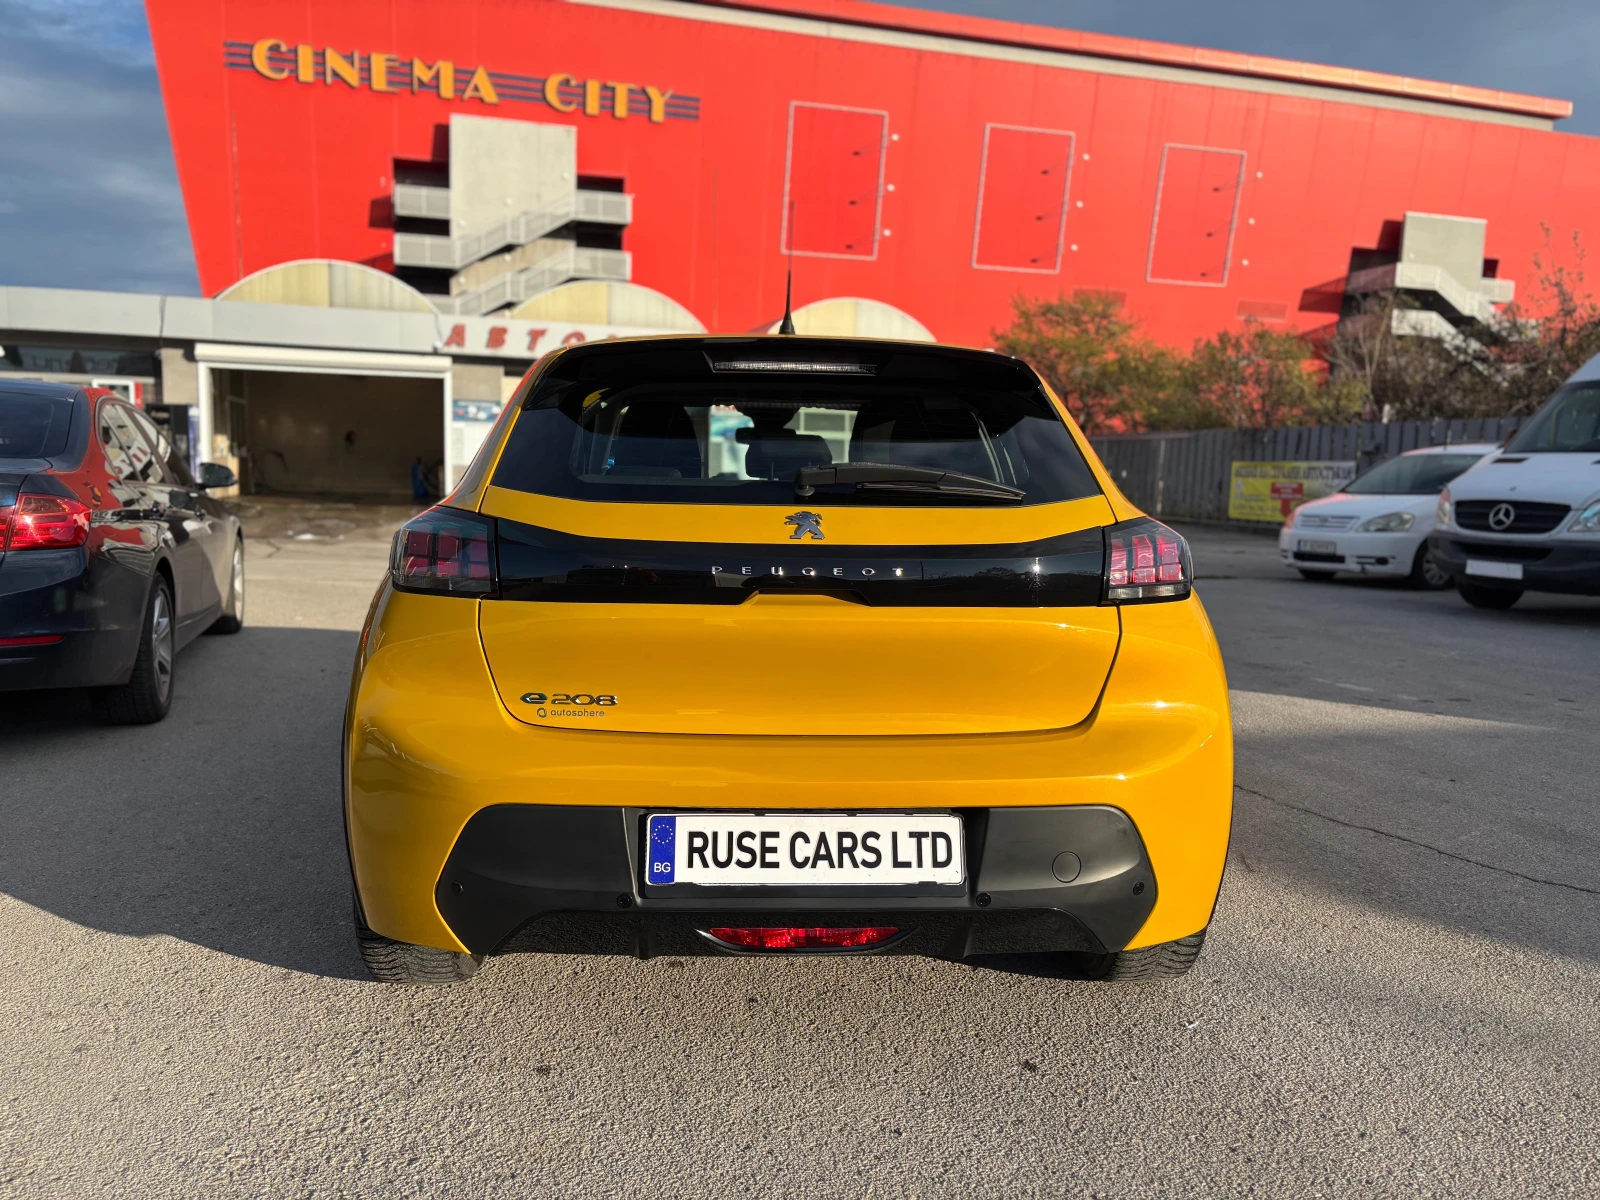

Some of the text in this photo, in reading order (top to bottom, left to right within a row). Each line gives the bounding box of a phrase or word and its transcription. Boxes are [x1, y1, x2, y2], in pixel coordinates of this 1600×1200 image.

[252, 38, 676, 123] CINEMA CITY
[711, 565, 904, 577] PEUGEOT
[550, 708, 605, 718] autosphere
[687, 831, 954, 869] RUSE CARS LTD
[653, 861, 672, 873] BG
